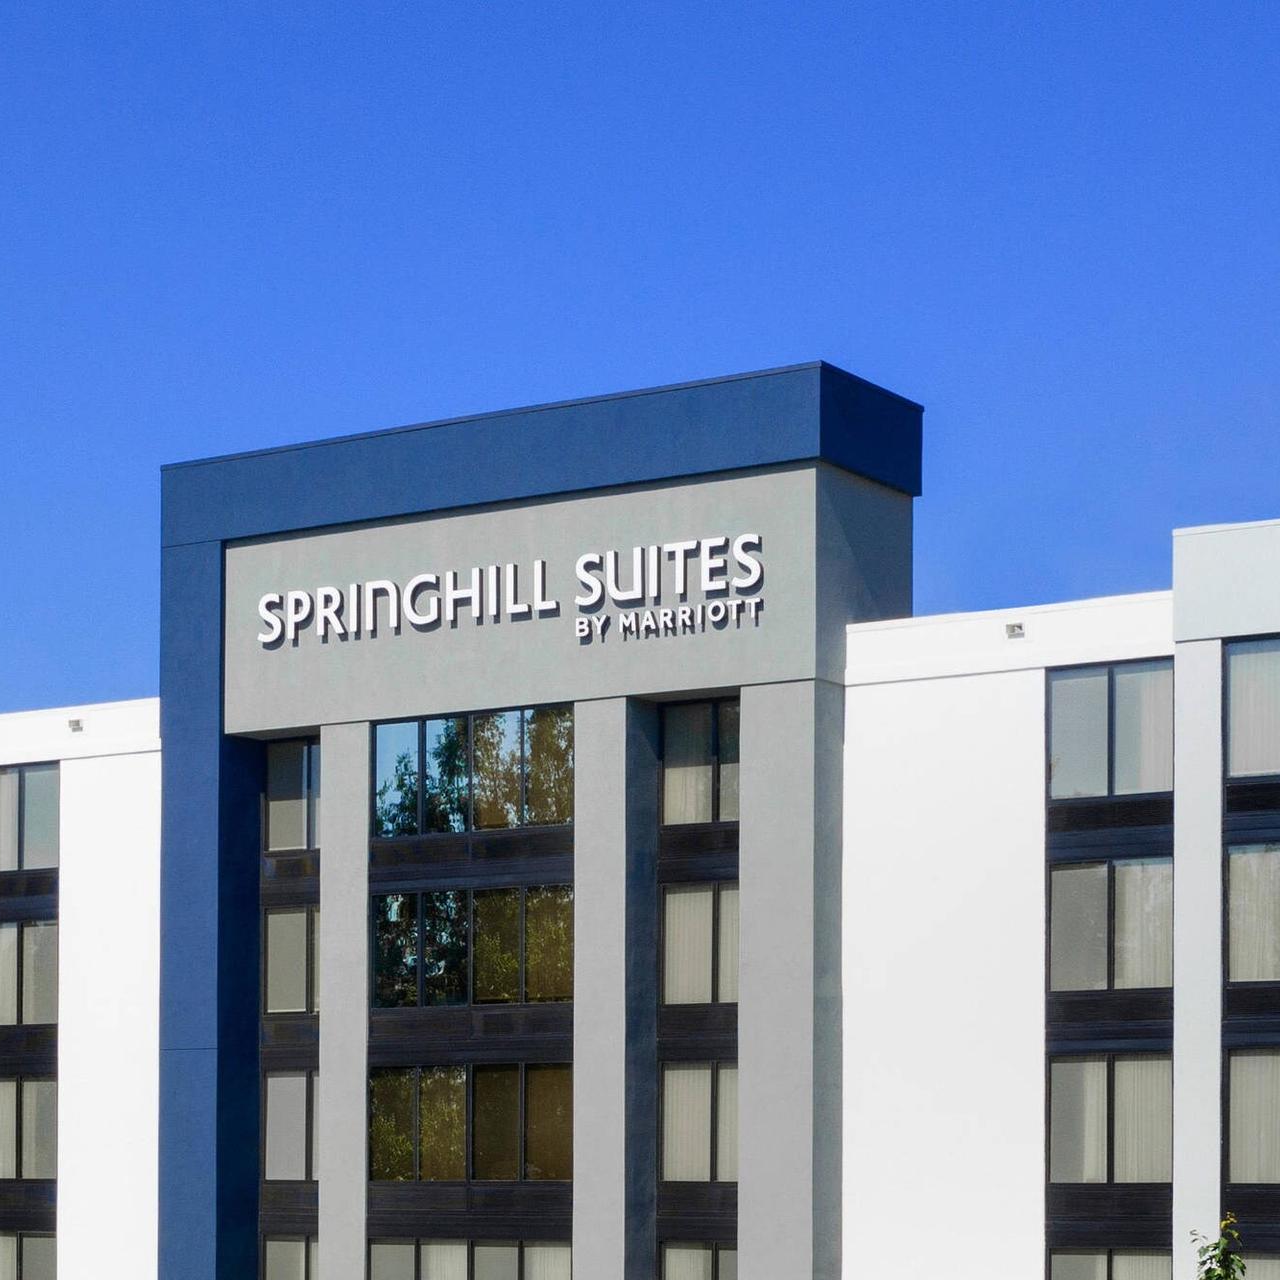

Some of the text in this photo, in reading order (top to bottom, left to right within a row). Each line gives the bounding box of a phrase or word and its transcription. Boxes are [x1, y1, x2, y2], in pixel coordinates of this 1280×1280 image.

[257, 533, 762, 644] SPRINGHILL SUITES
[575, 597, 762, 638] BY MARRIOTT
